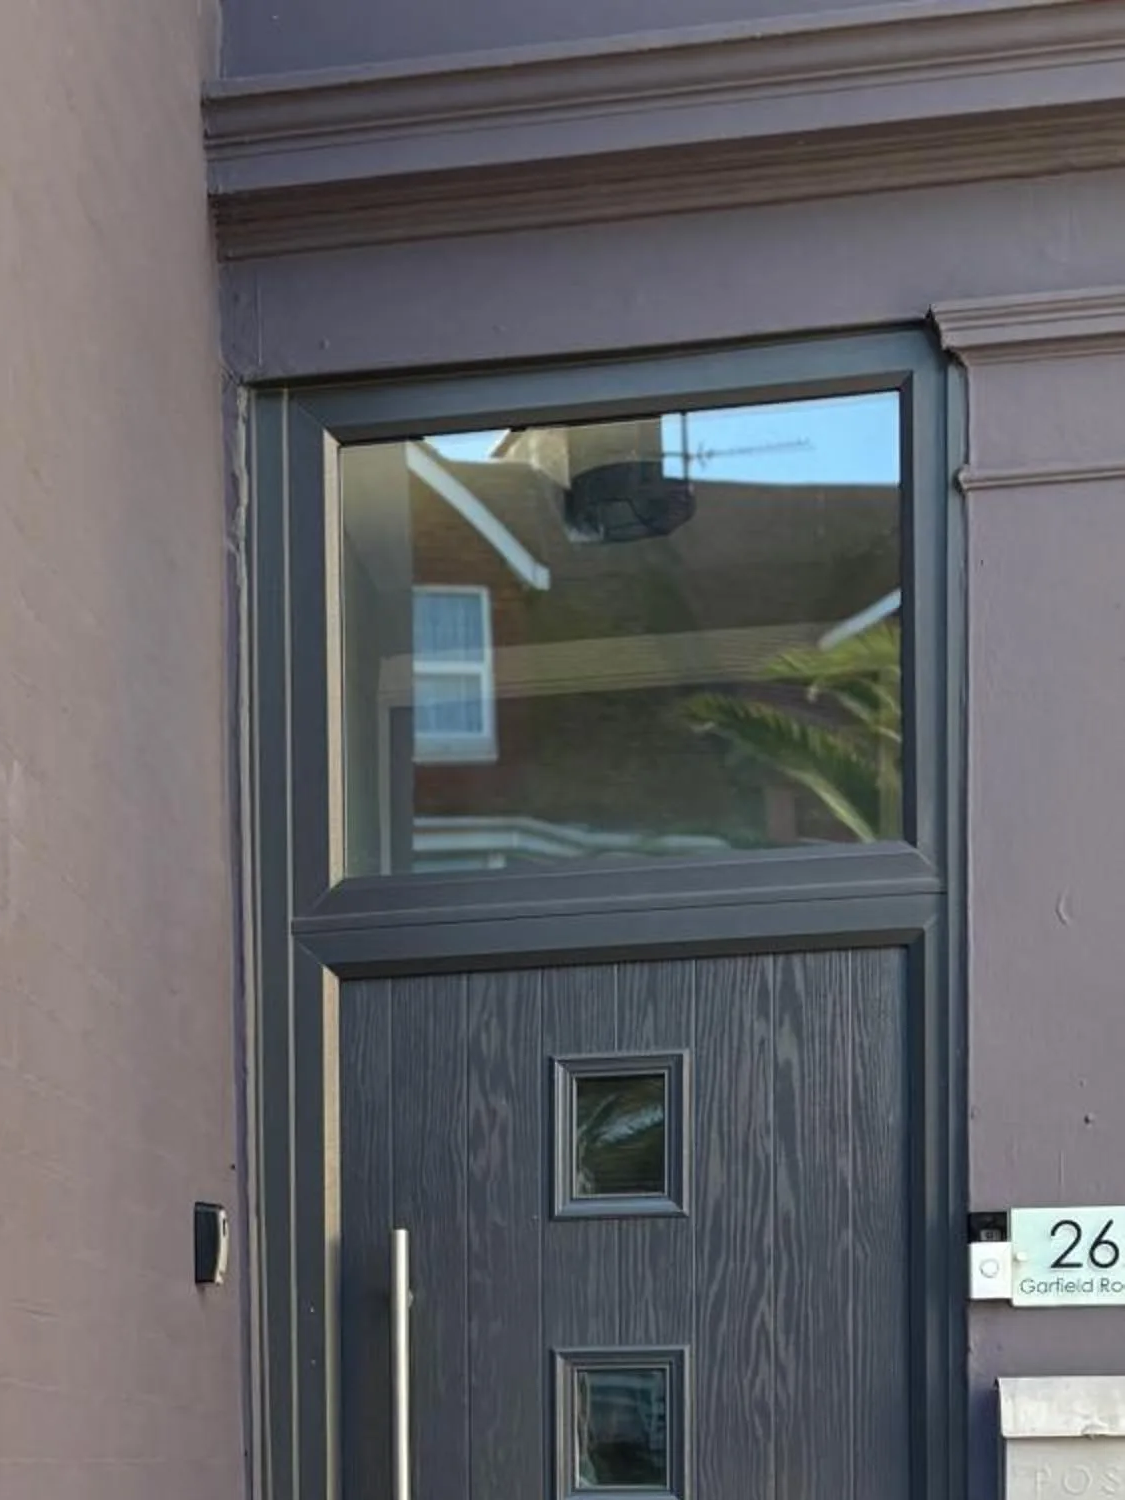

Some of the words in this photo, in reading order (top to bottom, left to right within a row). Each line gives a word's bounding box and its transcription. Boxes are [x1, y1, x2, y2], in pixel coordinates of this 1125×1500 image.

[1050, 1218, 1120, 1269] 26
[1020, 1276, 1094, 1294] Garfield
[1100, 1277, 1125, 1293] Ro
